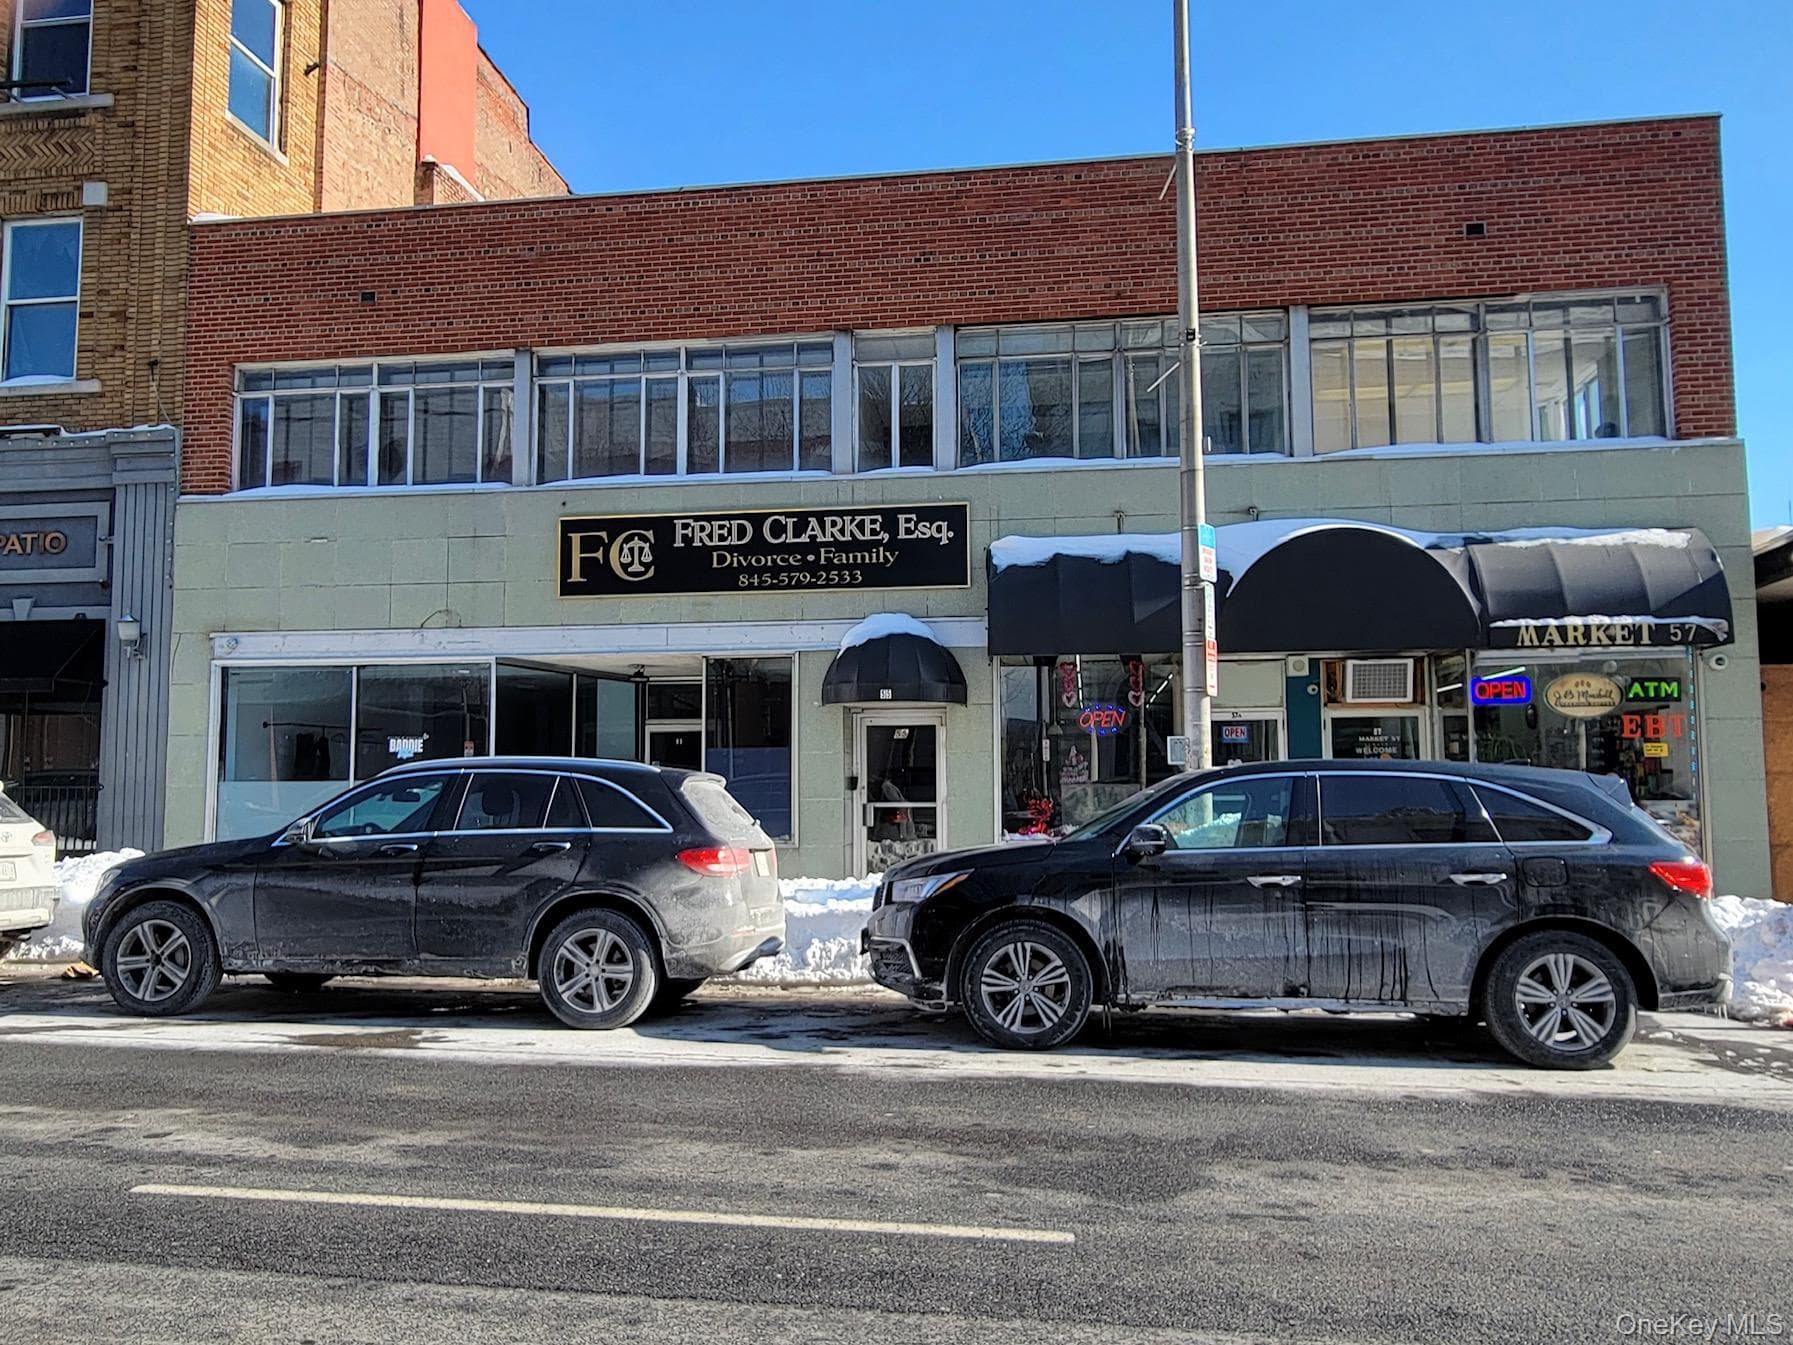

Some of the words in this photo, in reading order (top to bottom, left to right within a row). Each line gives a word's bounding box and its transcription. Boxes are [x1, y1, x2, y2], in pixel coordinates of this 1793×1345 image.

[673, 519, 753, 547] FRED
[763, 515, 890, 544] CLARKE,
[897, 513, 954, 545] Esq.
[712, 551, 802, 568] Divorce
[820, 546, 899, 567] Family
[738, 570, 863, 587] 845-579-2533
[1516, 623, 1656, 647] MARKET
[1669, 623, 1697, 642] 57
[1474, 680, 1527, 699] OPEN
[1627, 681, 1679, 699] ATM
[1079, 710, 1126, 728] OPEN
[1621, 714, 1685, 738] EBT
[1224, 726, 1246, 738] OPEN
[389, 738, 424, 753] BADDIE
[1355, 746, 1398, 755] WELCOME
